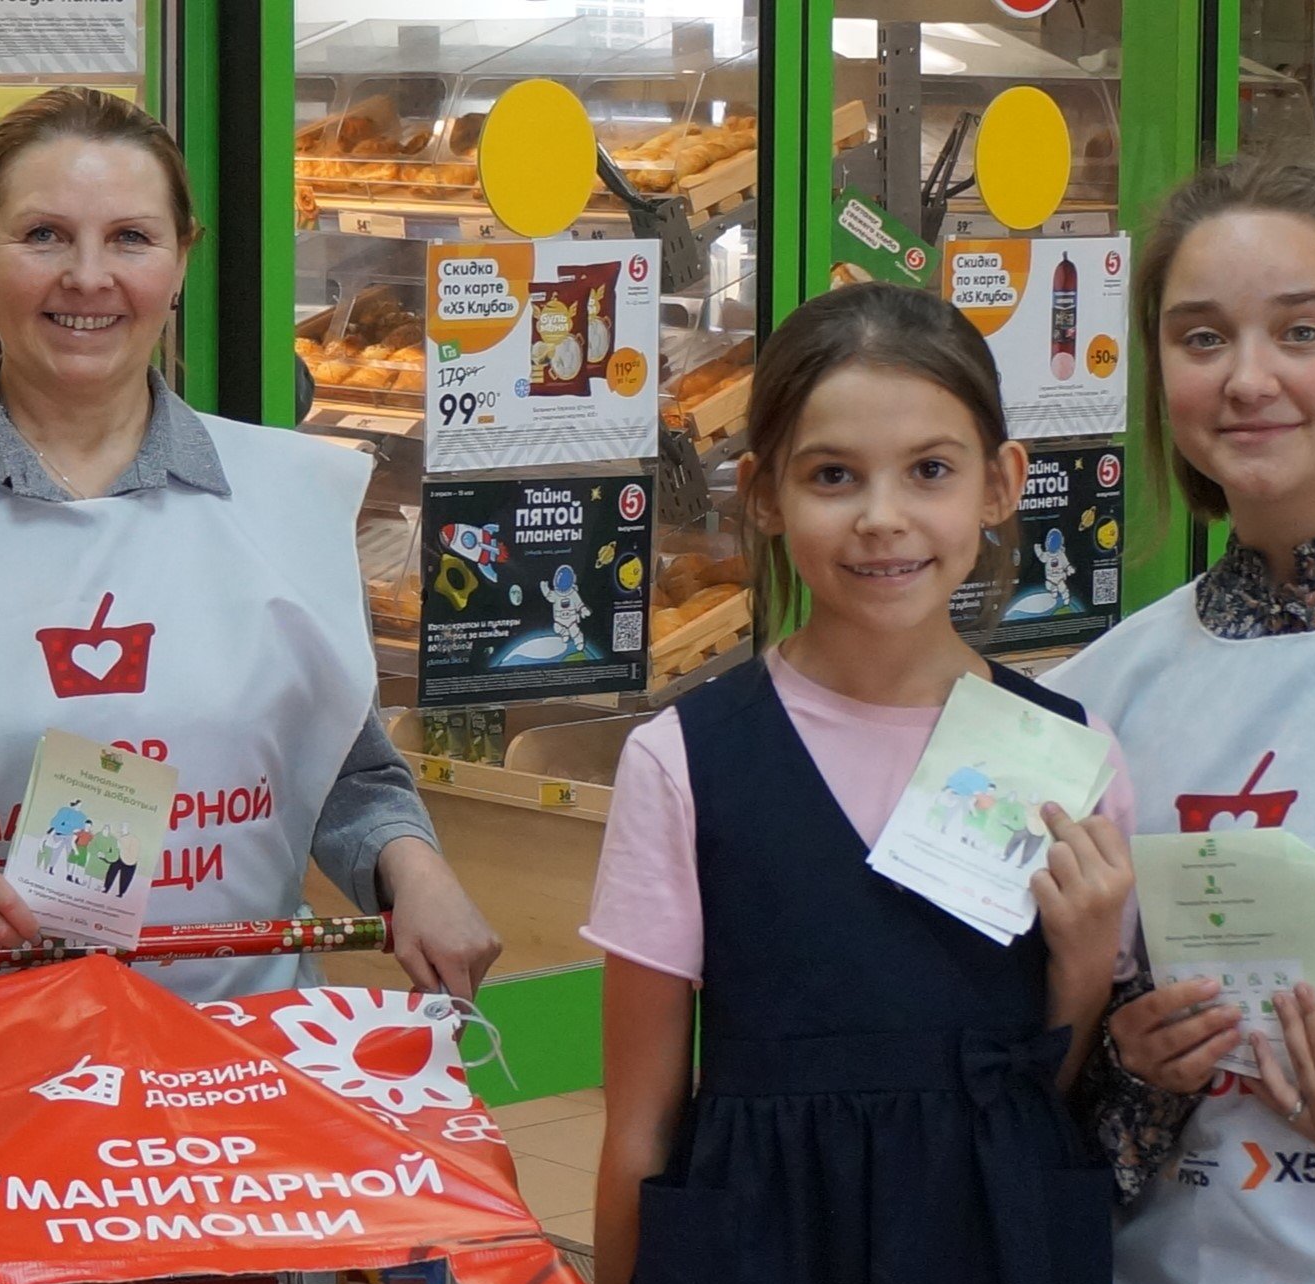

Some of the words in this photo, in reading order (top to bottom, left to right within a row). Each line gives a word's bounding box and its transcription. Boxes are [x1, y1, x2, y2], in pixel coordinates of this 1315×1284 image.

[443, 262, 493, 276] Скидка
[956, 256, 998, 269] Скидка
[956, 275, 970, 286] по
[973, 275, 1006, 288] карте
[443, 284, 461, 296] по
[465, 283, 504, 298] карте
[975, 290, 1013, 305] Клуба»
[467, 300, 514, 317] Клуба»
[1028, 460, 1060, 476] айна
[524, 488, 571, 504] Тайна
[515, 501, 583, 527] пятой
[515, 528, 583, 544] планеты
[54, 771, 102, 798] «Корзину
[80, 769, 136, 794] Наполните
[139, 1058, 278, 1090] КОРЗИНА
[145, 1079, 287, 1109] ДОБРОТЫ
[98, 1136, 257, 1168] СБОР
[46, 1208, 365, 1245] ПОМОЩИ
